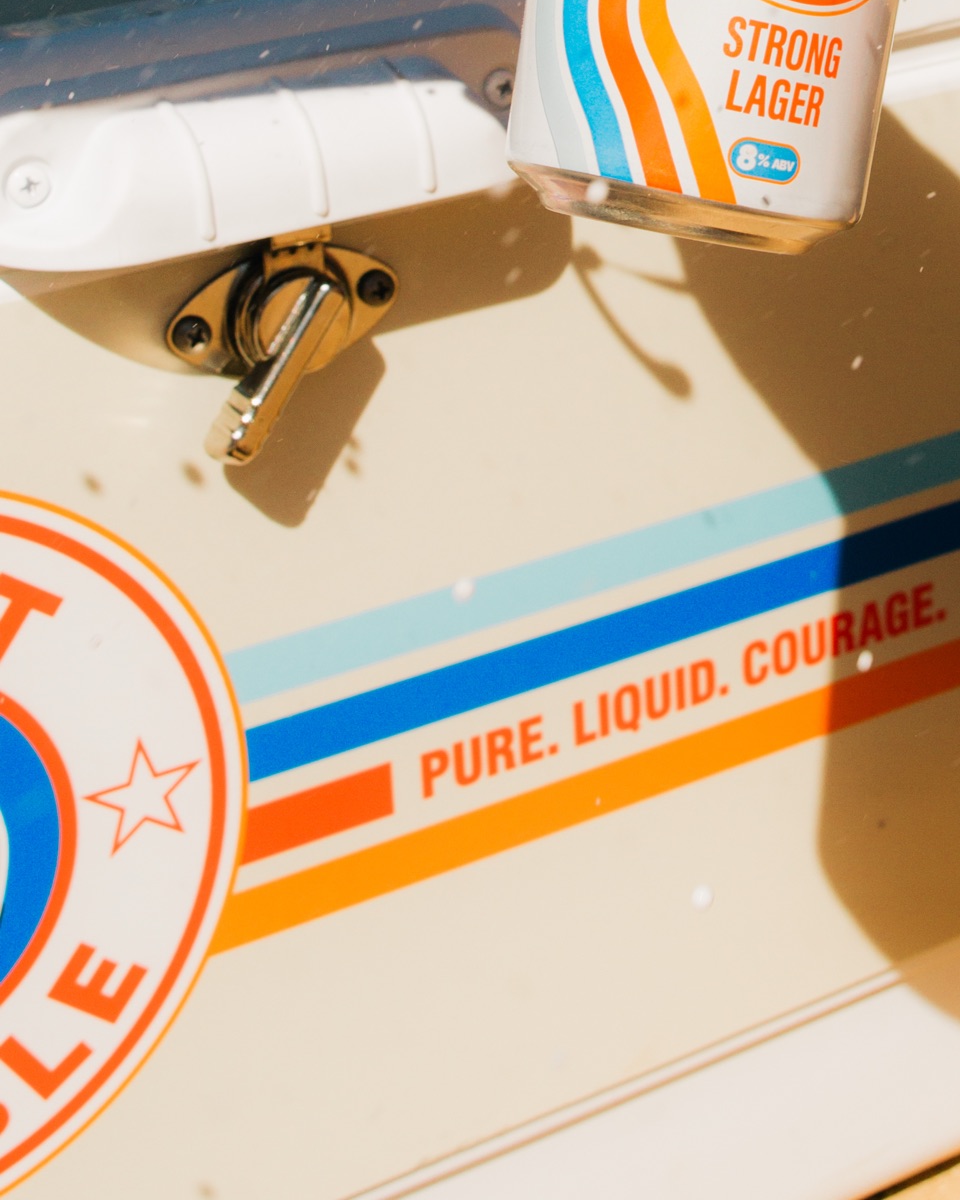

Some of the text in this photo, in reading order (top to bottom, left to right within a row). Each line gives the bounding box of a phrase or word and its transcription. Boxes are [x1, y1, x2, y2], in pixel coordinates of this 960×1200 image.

[723, 16, 844, 80] STRONG
[725, 69, 825, 128] LAGER
[771, 158, 796, 173] ABV
[418, 582, 947, 800] PURE. LIQUID. COURAGE.
